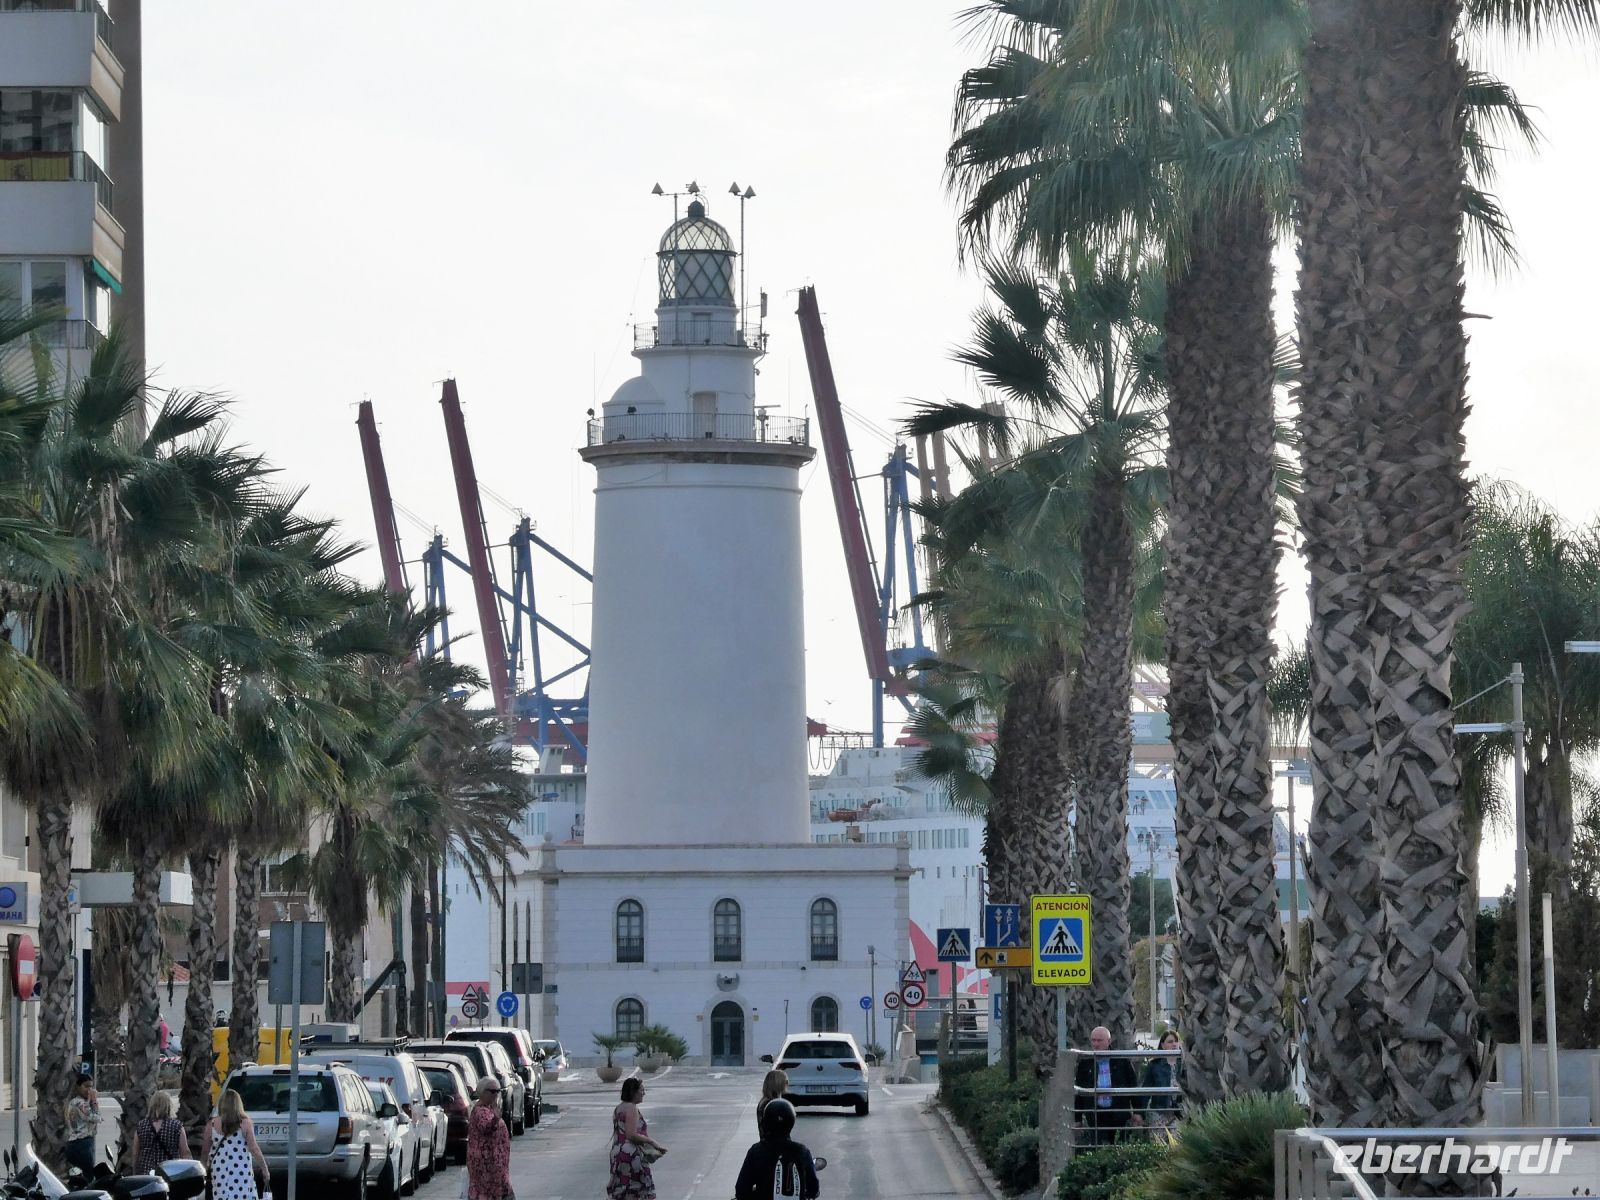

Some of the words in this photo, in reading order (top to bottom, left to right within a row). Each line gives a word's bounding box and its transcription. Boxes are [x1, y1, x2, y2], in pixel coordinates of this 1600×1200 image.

[1035, 900, 1089, 911] ATENCIÓN
[1037, 969, 1086, 978] ELEVADO
[906, 991, 920, 999] 40
[80, 1061, 90, 1074] P
[259, 1126, 280, 1135] 2317
